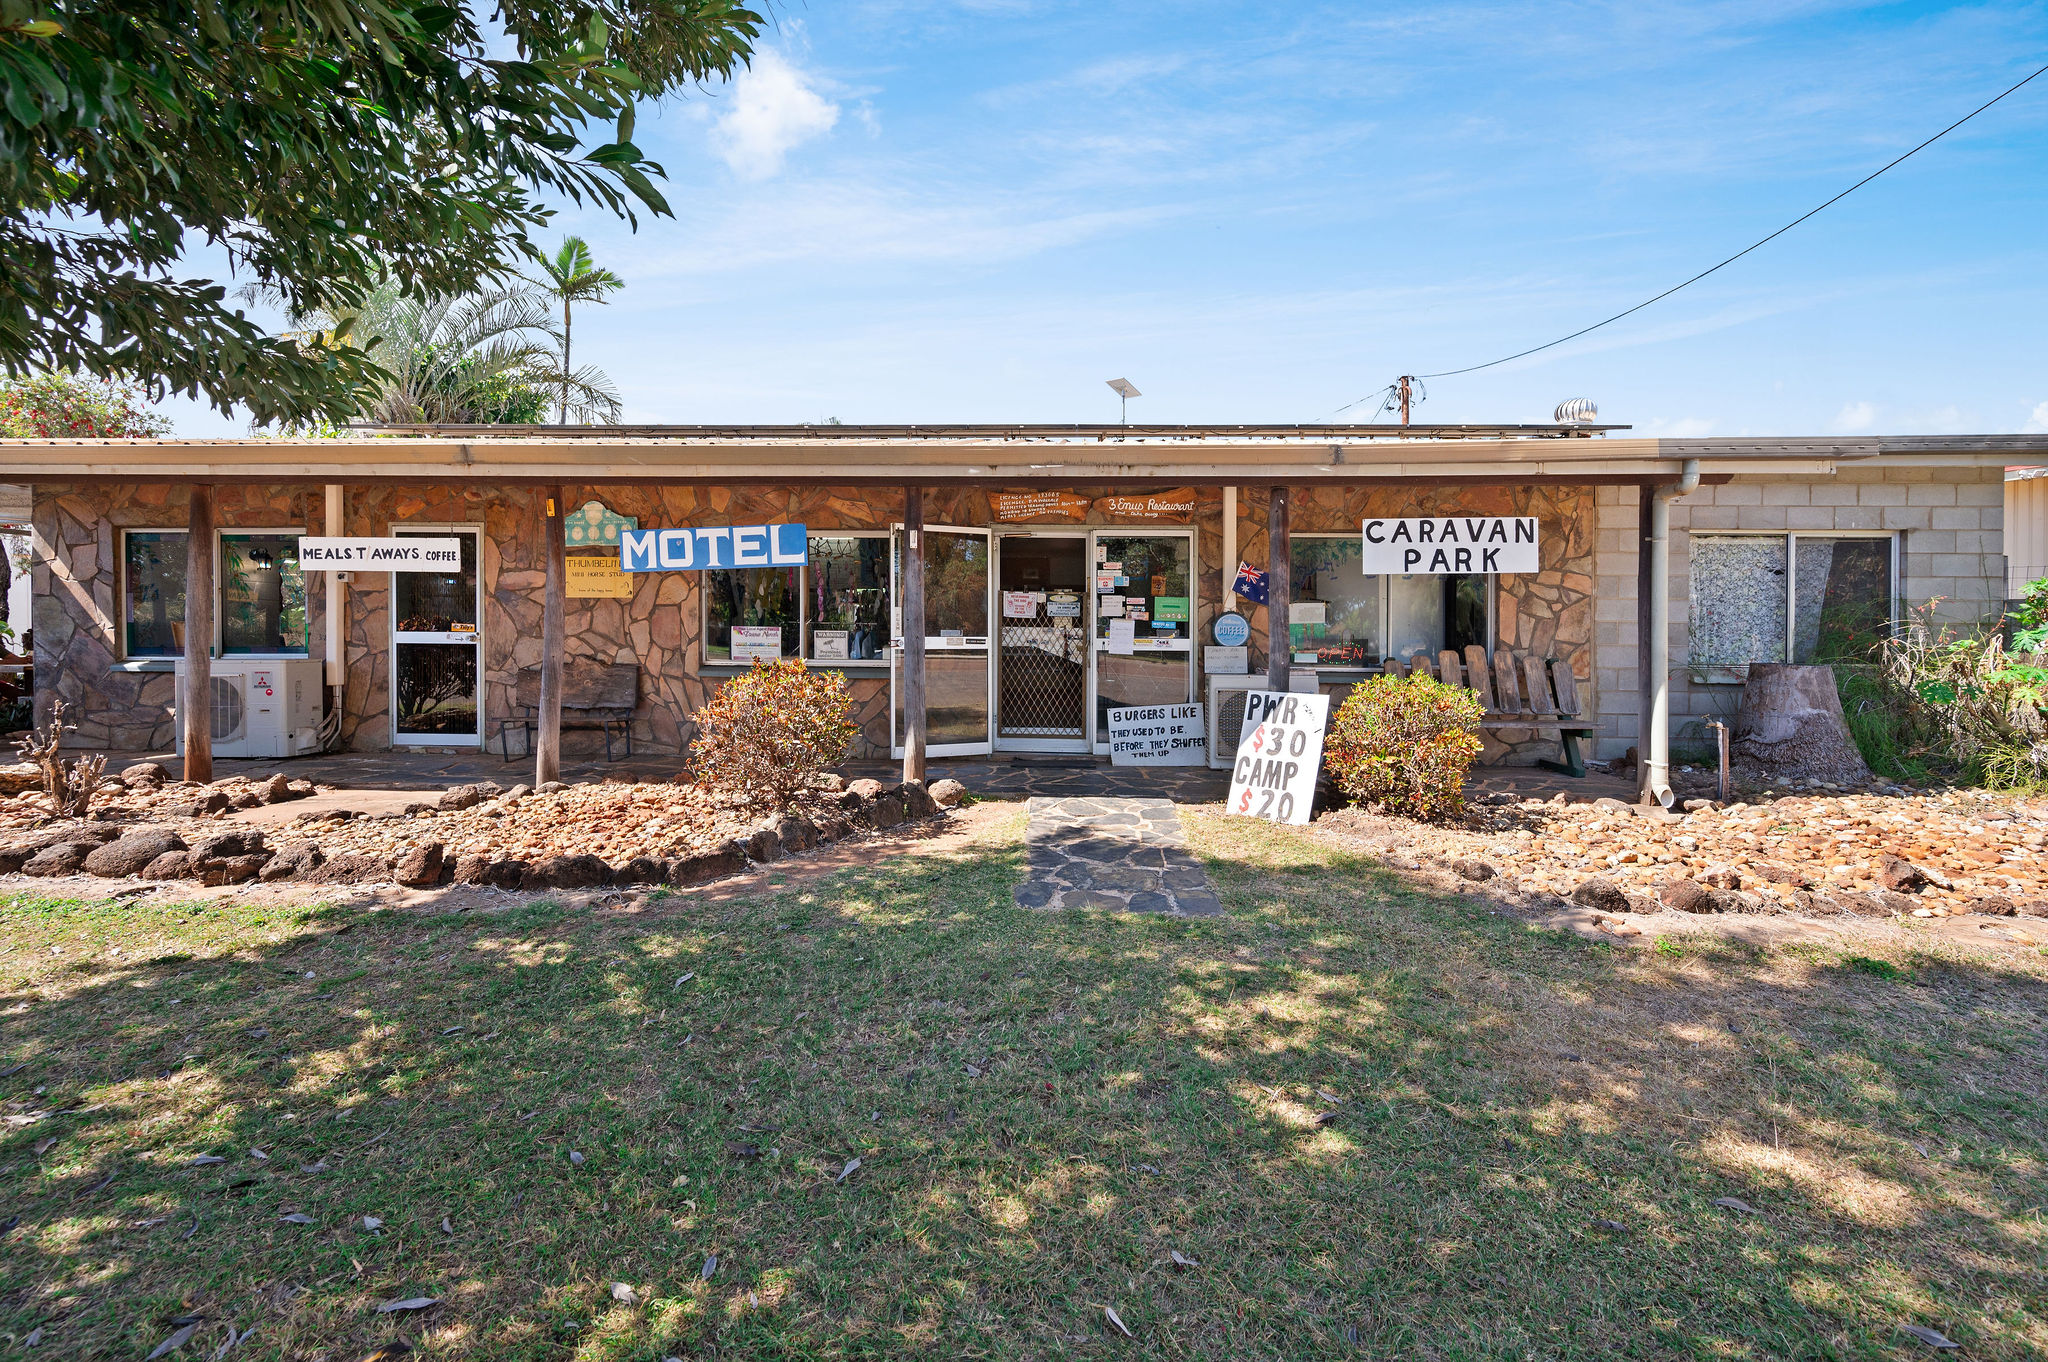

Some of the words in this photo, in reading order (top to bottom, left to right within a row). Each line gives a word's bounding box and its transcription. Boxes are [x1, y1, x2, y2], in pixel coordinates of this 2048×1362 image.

[1108, 498, 1116, 510] 3
[1117, 498, 1144, 510] Emus
[1148, 498, 1195, 511] Restaurant
[1365, 518, 1534, 544] CARAVAN
[621, 524, 806, 570] MOTEL
[566, 559, 621, 568] THUMBELIN
[1404, 547, 1501, 573] PARK
[1218, 625, 1245, 635] COFFEE
[1318, 647, 1364, 659] OPEN
[1113, 708, 1165, 722] BURGERS
[1171, 706, 1197, 719] LIKE
[1247, 693, 1299, 725] PWR
[1111, 729, 1130, 738] THEY
[1132, 727, 1153, 736] USED
[1154, 726, 1165, 736] TO
[1113, 741, 1144, 752] BEFORE
[1149, 738, 1169, 750] THEY
[1235, 755, 1299, 791] CAMP
